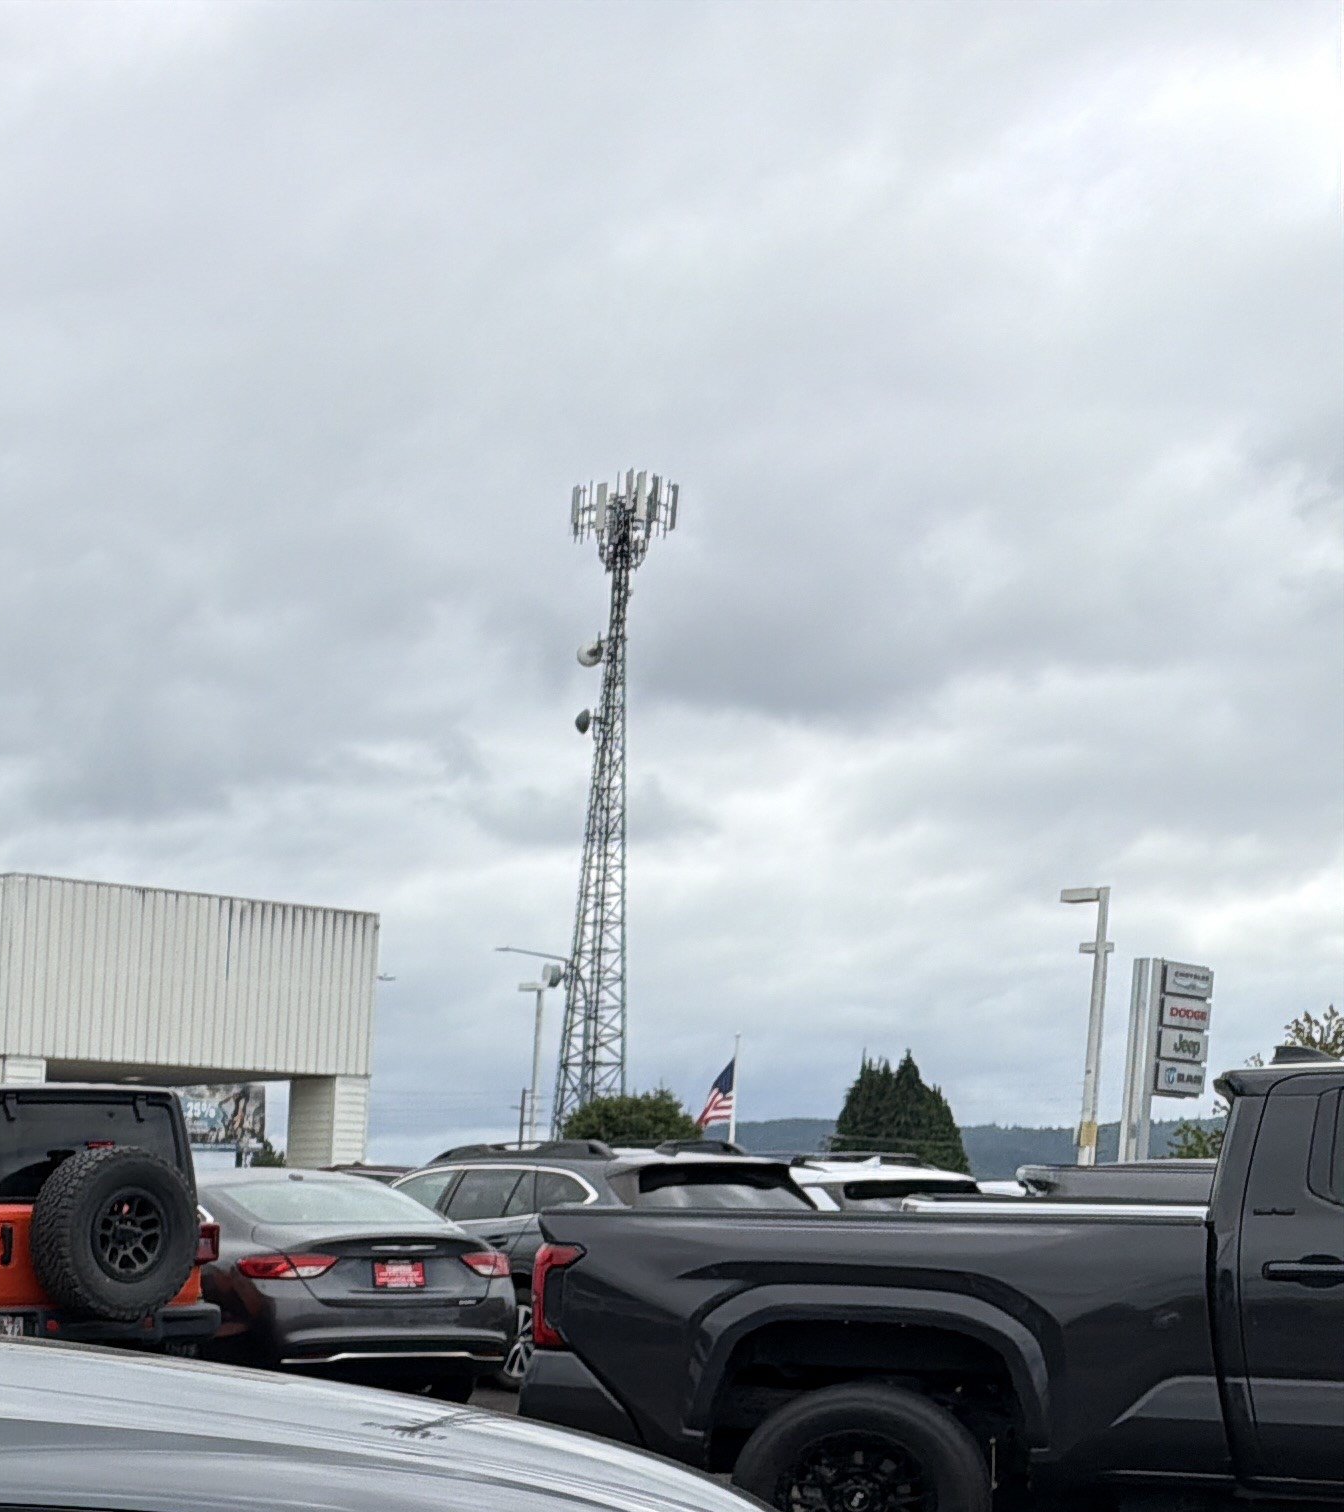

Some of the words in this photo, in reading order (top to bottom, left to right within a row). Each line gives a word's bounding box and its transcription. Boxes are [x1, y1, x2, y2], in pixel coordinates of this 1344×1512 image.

[1170, 1007, 1208, 1021] DODGE
[1173, 1033, 1201, 1058] Jeep
[1177, 1073, 1203, 1085] RAM
